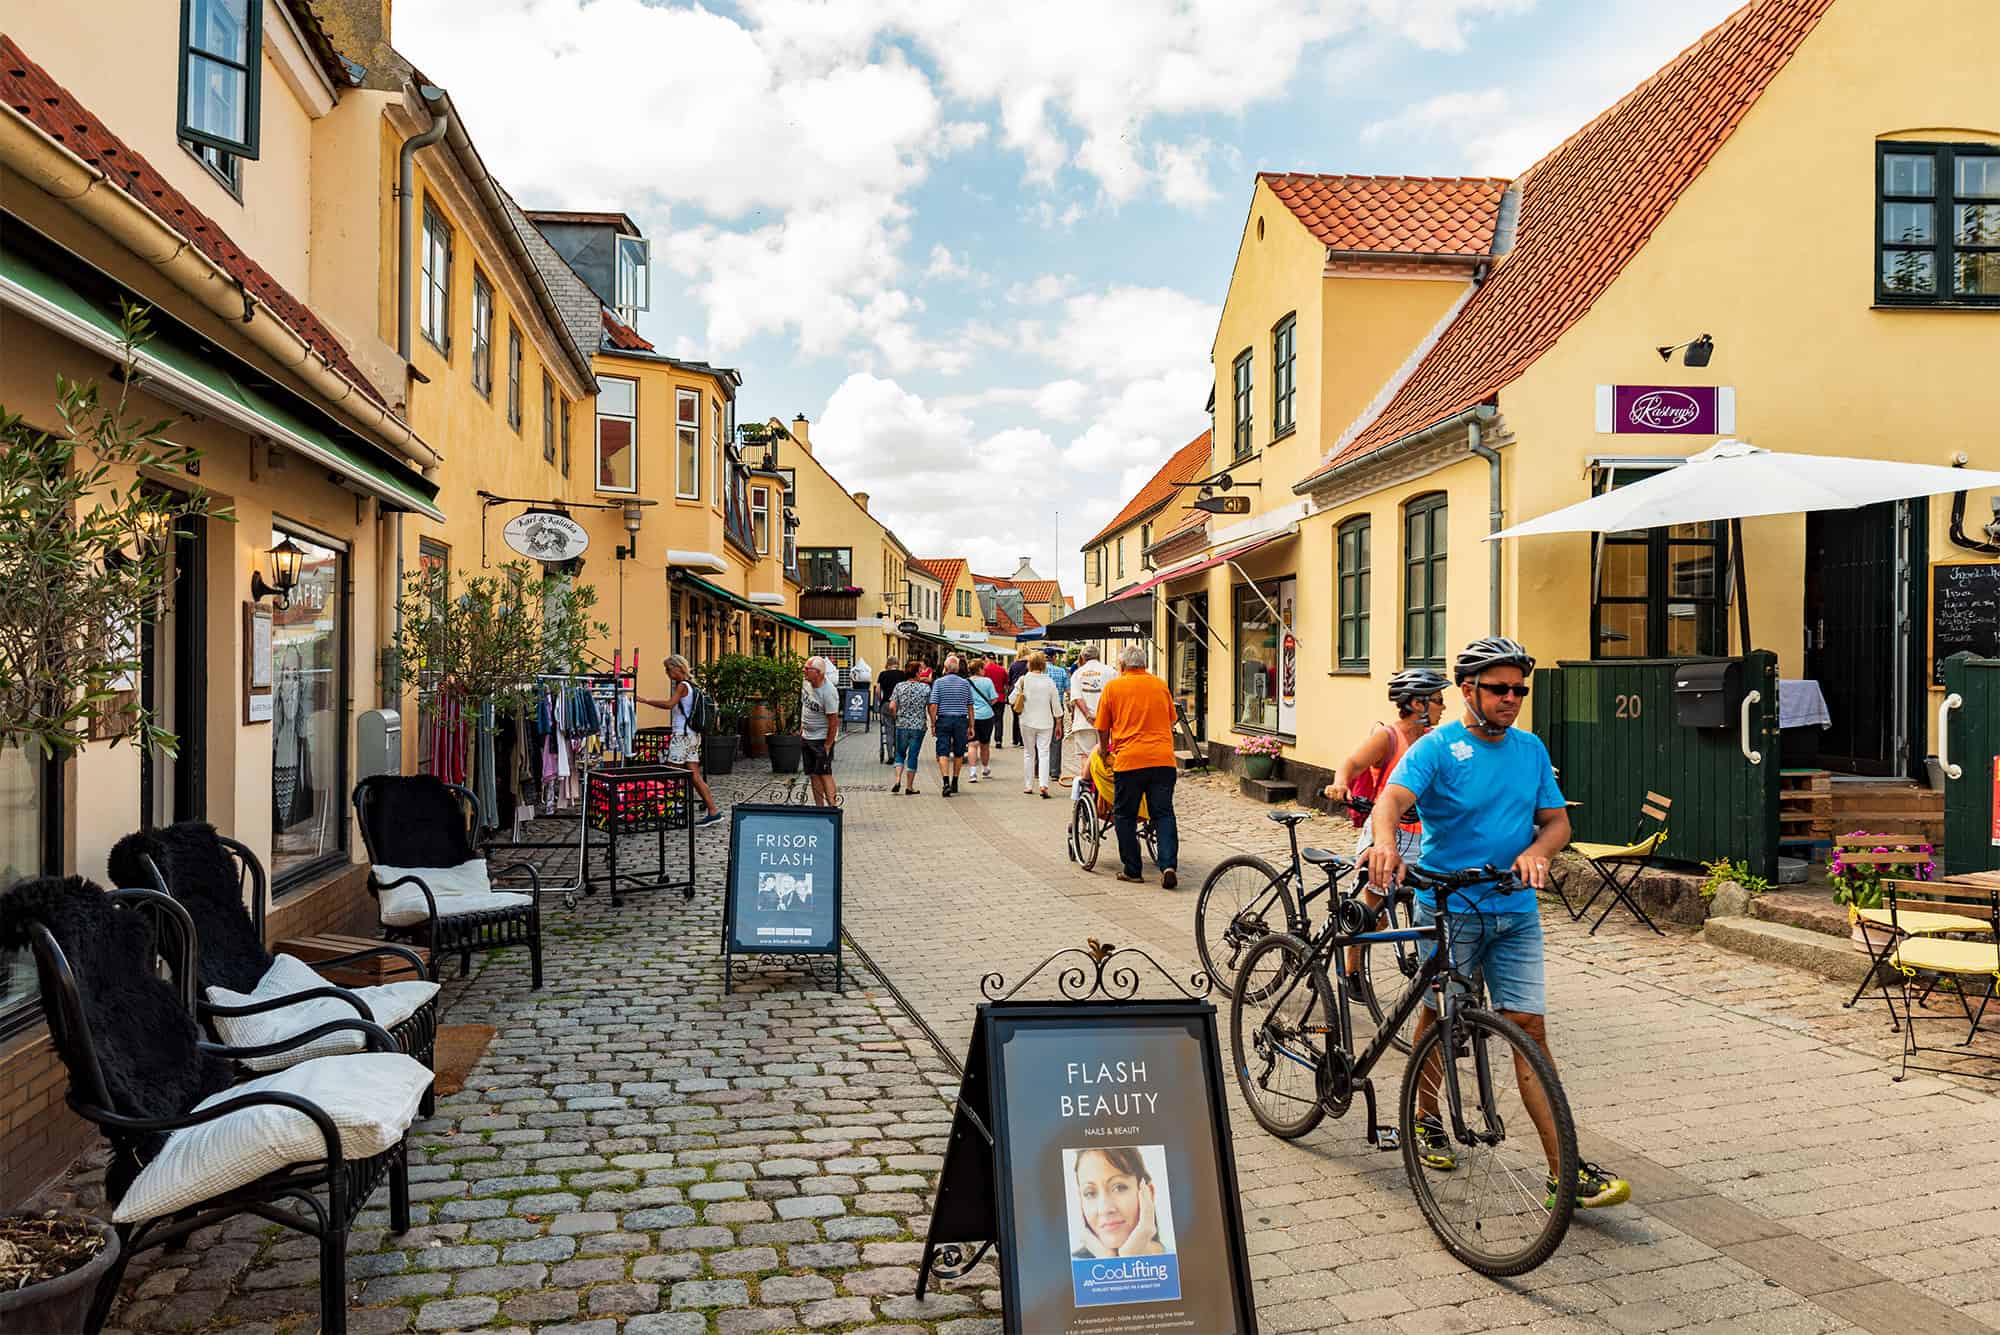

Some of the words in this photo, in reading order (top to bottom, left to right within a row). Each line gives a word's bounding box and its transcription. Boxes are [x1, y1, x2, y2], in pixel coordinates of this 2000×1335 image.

[1629, 395, 1696, 425] Rastrup's
[1615, 694, 1642, 719] 20
[756, 833, 818, 848] FRISØR
[760, 852, 814, 866] FLASH
[1067, 1061, 1147, 1084] FLASH
[1060, 1092, 1158, 1117] BEAUTY
[1084, 1127, 1105, 1136] NAILS
[1107, 1127, 1113, 1135] &
[1114, 1126, 1140, 1136] BEAUTY
[1091, 1259, 1168, 1280] CooLifting
